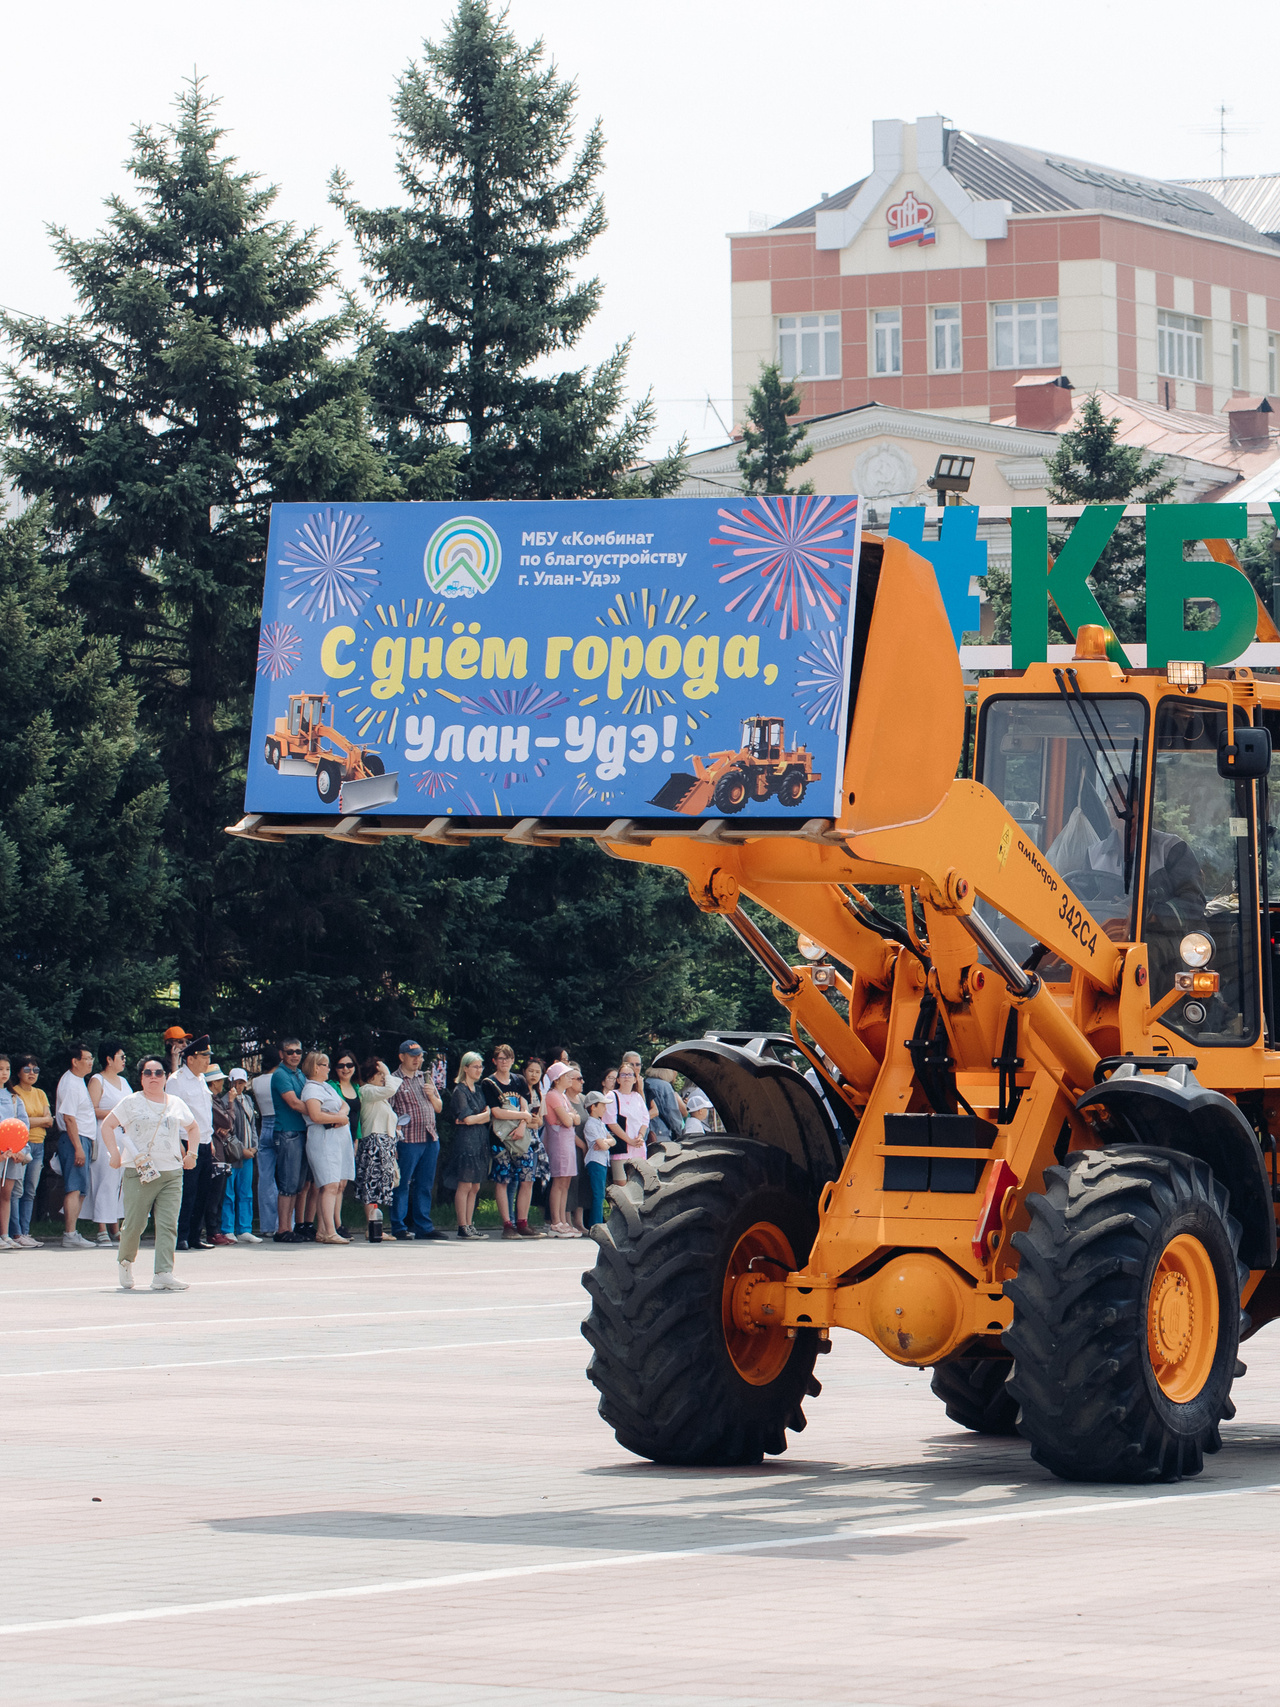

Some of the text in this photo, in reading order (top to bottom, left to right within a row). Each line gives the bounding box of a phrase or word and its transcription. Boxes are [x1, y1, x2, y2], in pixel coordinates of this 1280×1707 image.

[521, 530, 655, 547] МБУ «Комбинат
[519, 549, 688, 569] по благоустройству
[518, 570, 622, 588] г. Улан-Удэ»
[320, 621, 780, 701] С днём города,
[404, 714, 678, 781] Улан-Удэ!
